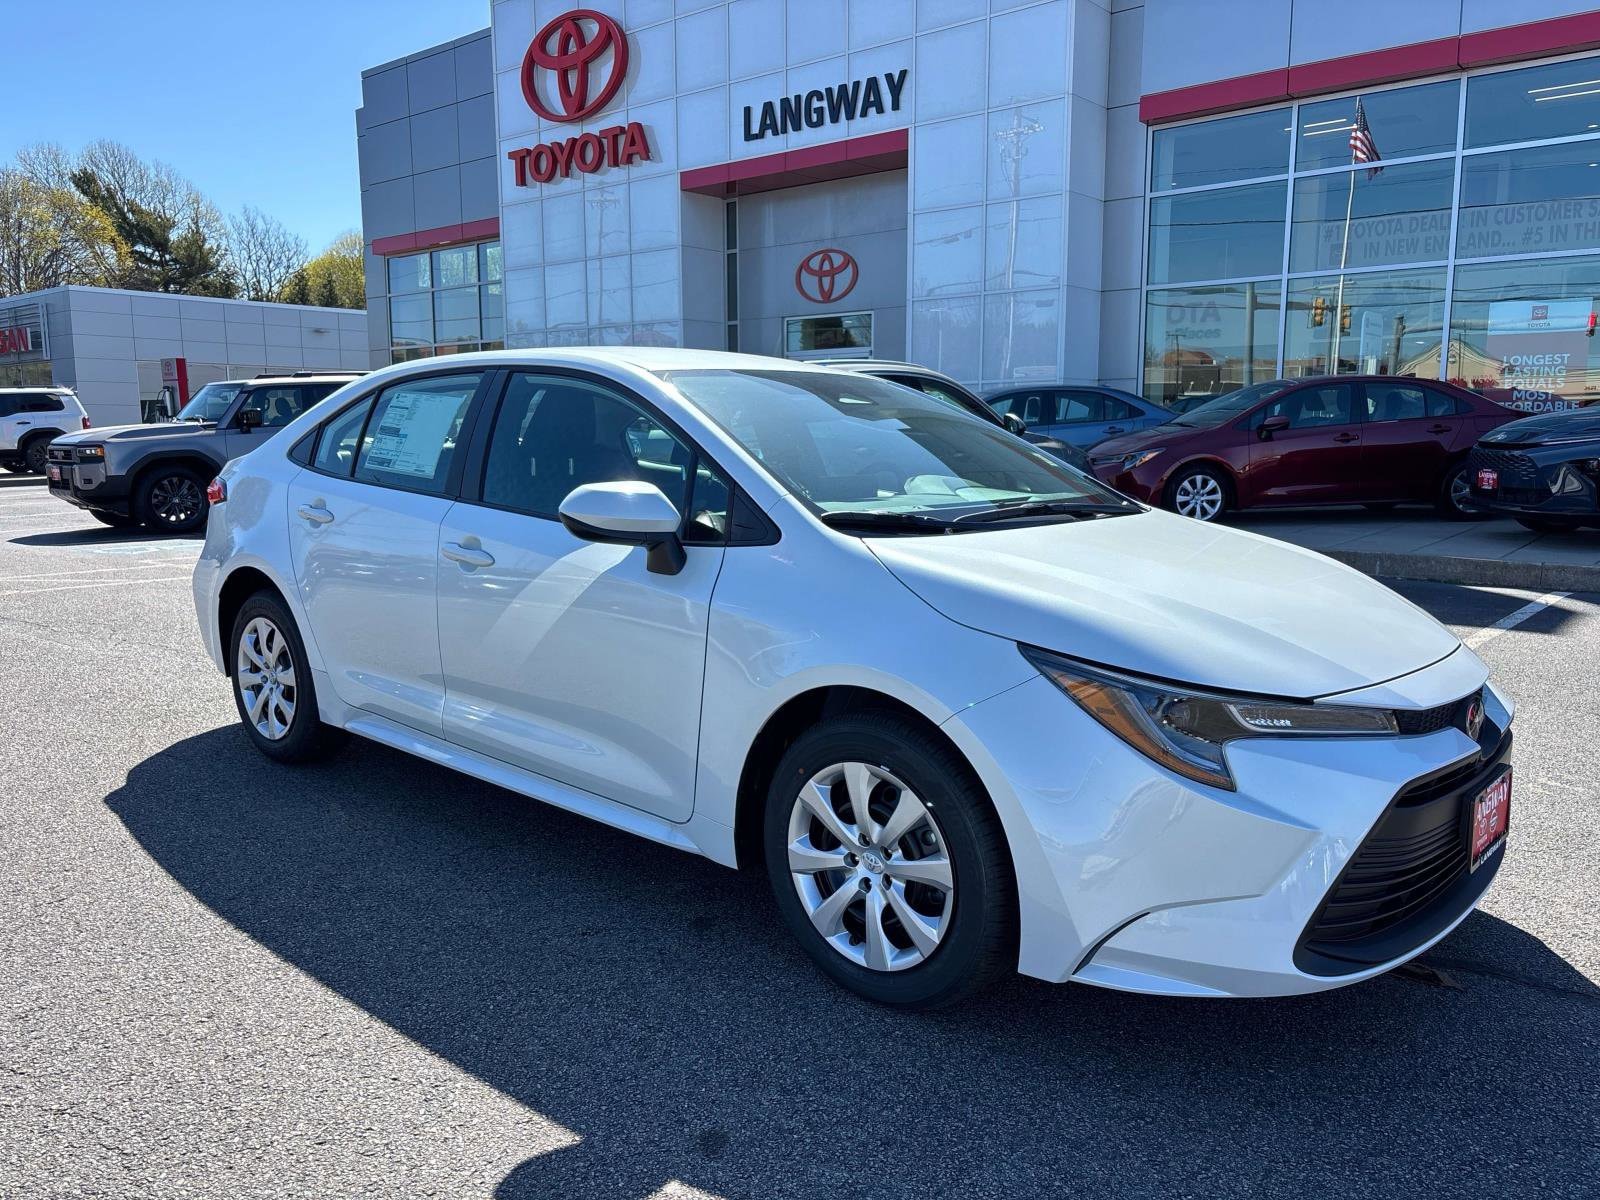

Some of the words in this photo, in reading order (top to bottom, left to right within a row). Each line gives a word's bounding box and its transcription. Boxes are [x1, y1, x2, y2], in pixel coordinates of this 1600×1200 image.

[743, 69, 908, 142] LANGWAY
[508, 122, 652, 187] TOYOTA
[1346, 217, 1403, 240] OYOTA
[1408, 211, 1466, 234] DEAL
[1470, 209, 1488, 228] IN
[1494, 201, 1583, 226] CUSTOMER
[1362, 241, 1380, 259] IN
[1384, 238, 1420, 257] NEW
[1521, 225, 1543, 246] #5
[1549, 224, 1568, 243] IN
[1575, 221, 1600, 240] TH
[1503, 353, 1571, 366] LONGEST
[1504, 366, 1566, 378] LASTING
[1504, 377, 1565, 389] EQUALS
[1512, 389, 1554, 400] MOST
